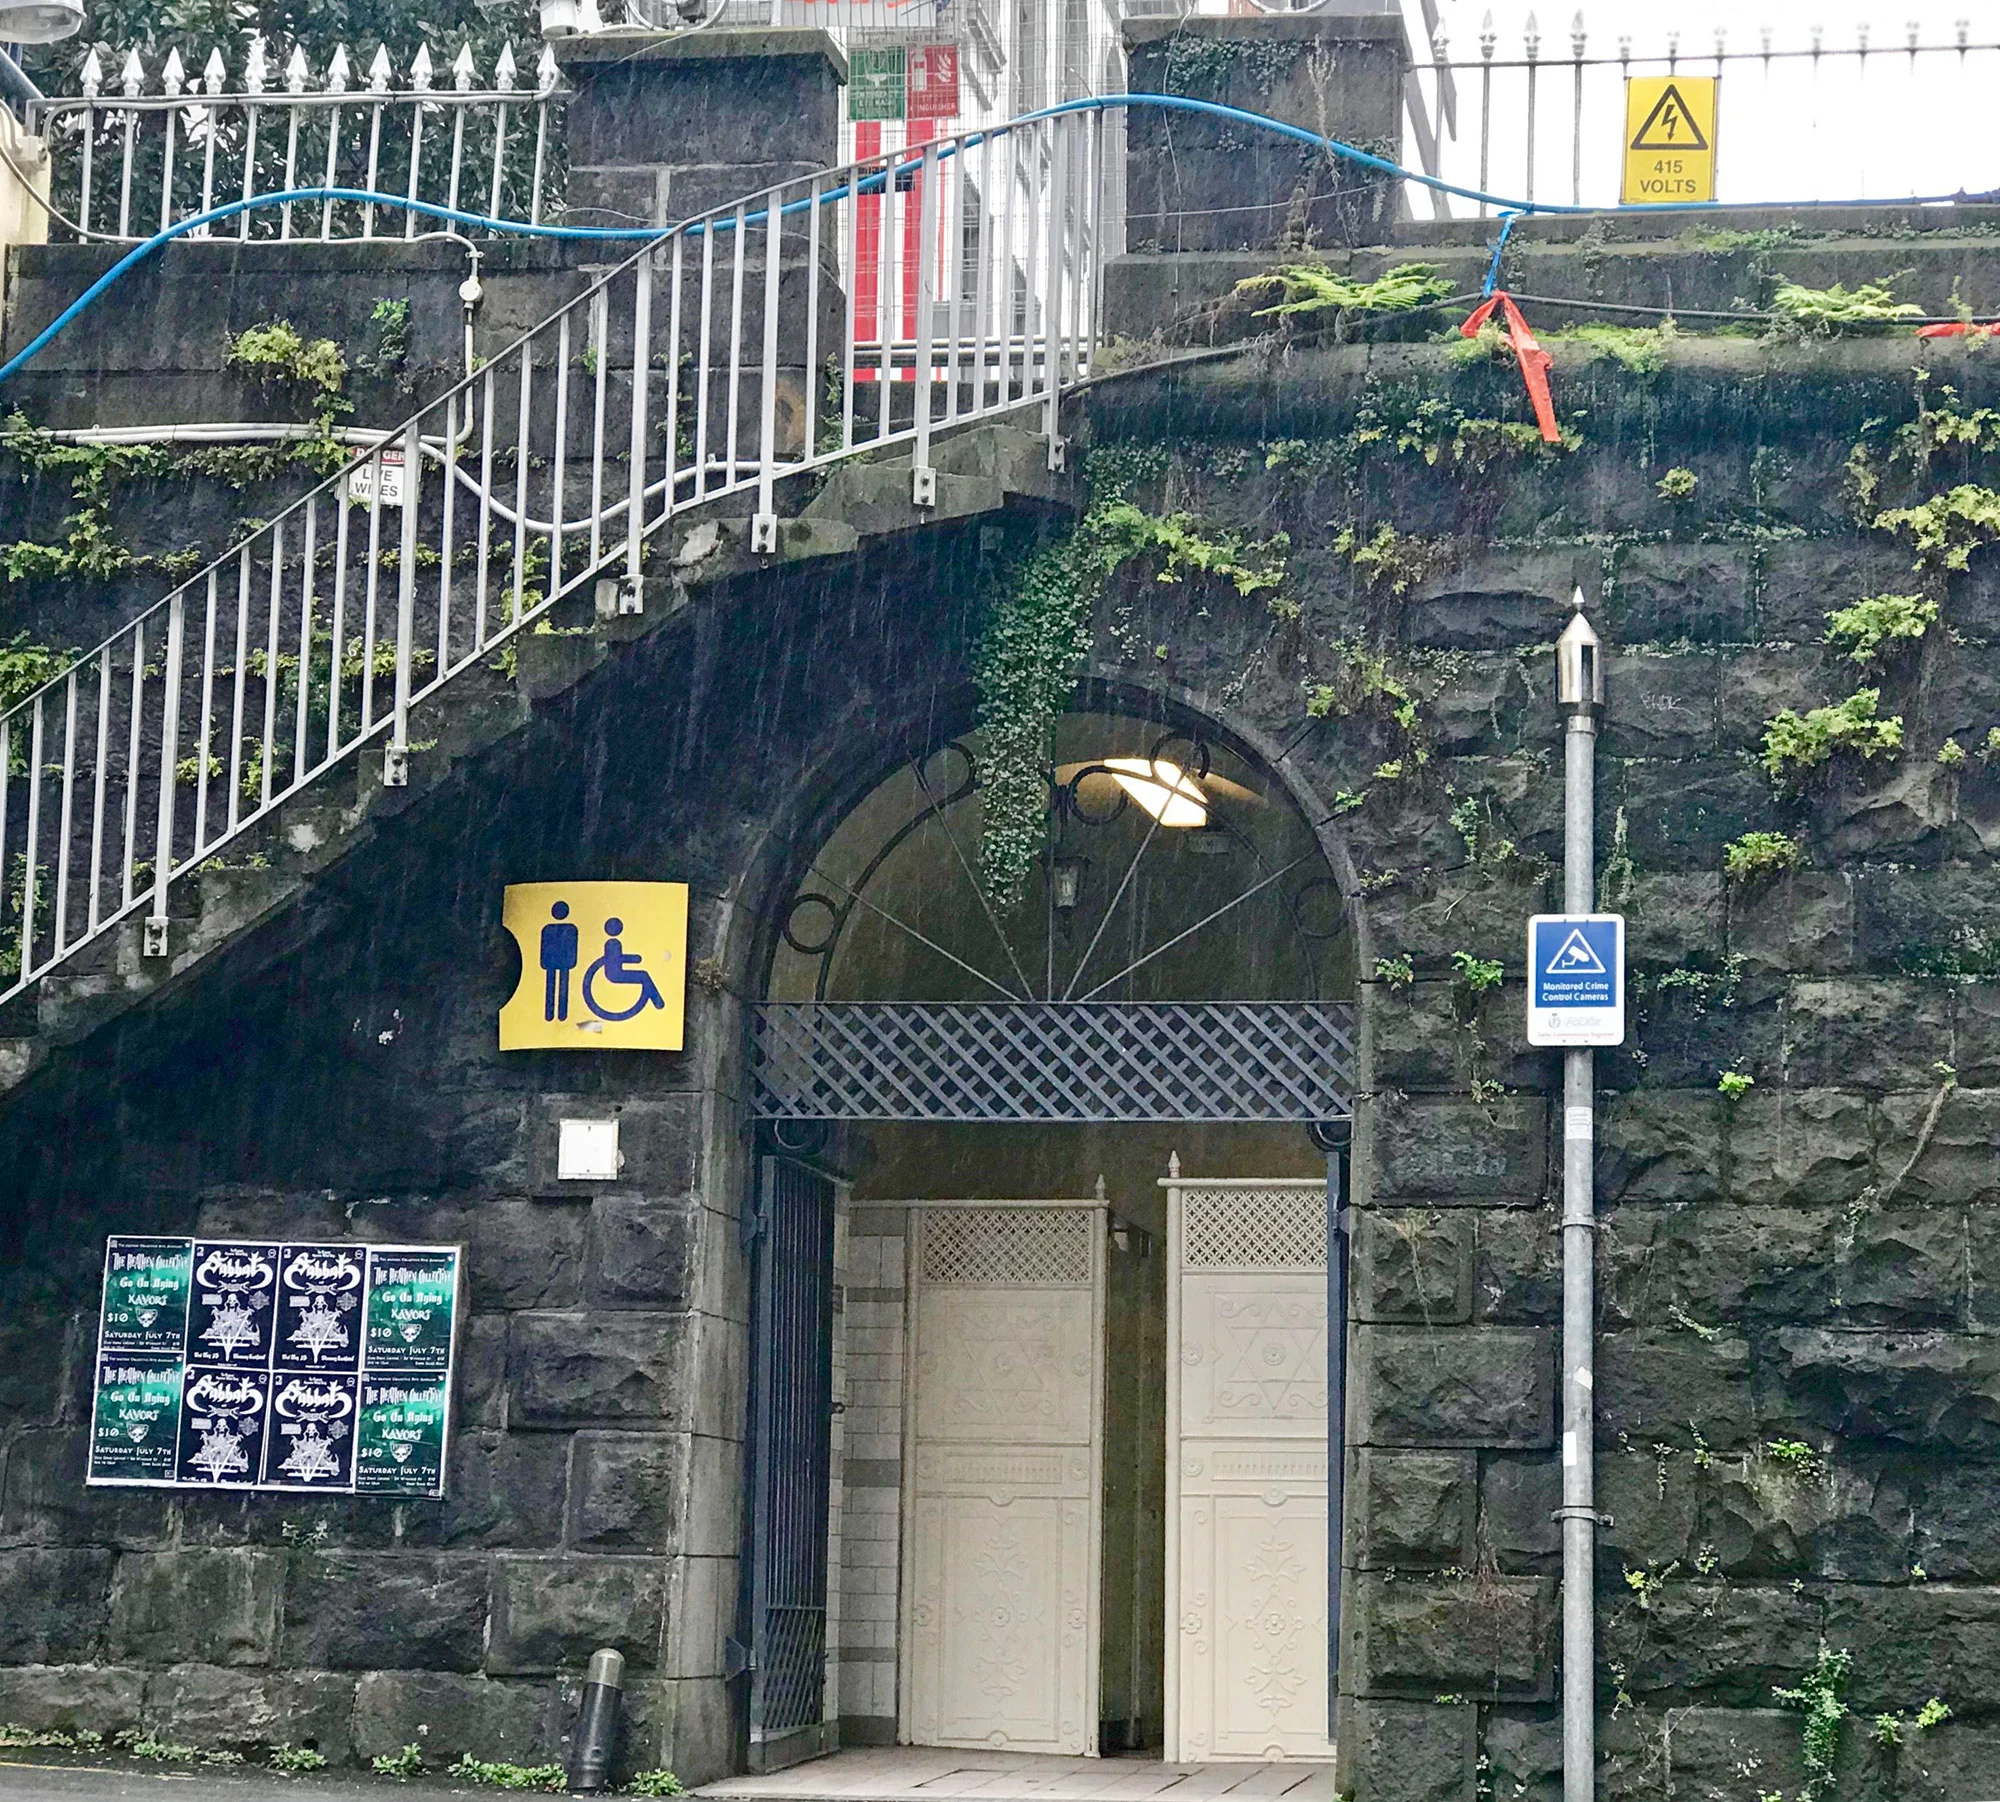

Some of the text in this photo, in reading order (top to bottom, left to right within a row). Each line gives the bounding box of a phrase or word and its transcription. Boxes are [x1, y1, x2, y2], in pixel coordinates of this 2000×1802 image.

[1654, 160, 1683, 174] 415
[1640, 179, 1696, 193] VOLTS
[356, 447, 405, 461] DGER
[363, 468, 393, 482] LE
[355, 482, 398, 497] WIES
[1543, 982, 1609, 991] Monitored Crime
[1542, 993, 1608, 1001] Control Cameras
[119, 1277, 133, 1288] Go
[382, 1291, 396, 1303] Go
[106, 1313, 128, 1323] $10
[370, 1328, 392, 1338] $10
[110, 1391, 124, 1402] Go
[373, 1411, 387, 1423] Go
[98, 1427, 120, 1437] $10
[360, 1447, 383, 1458] $10
